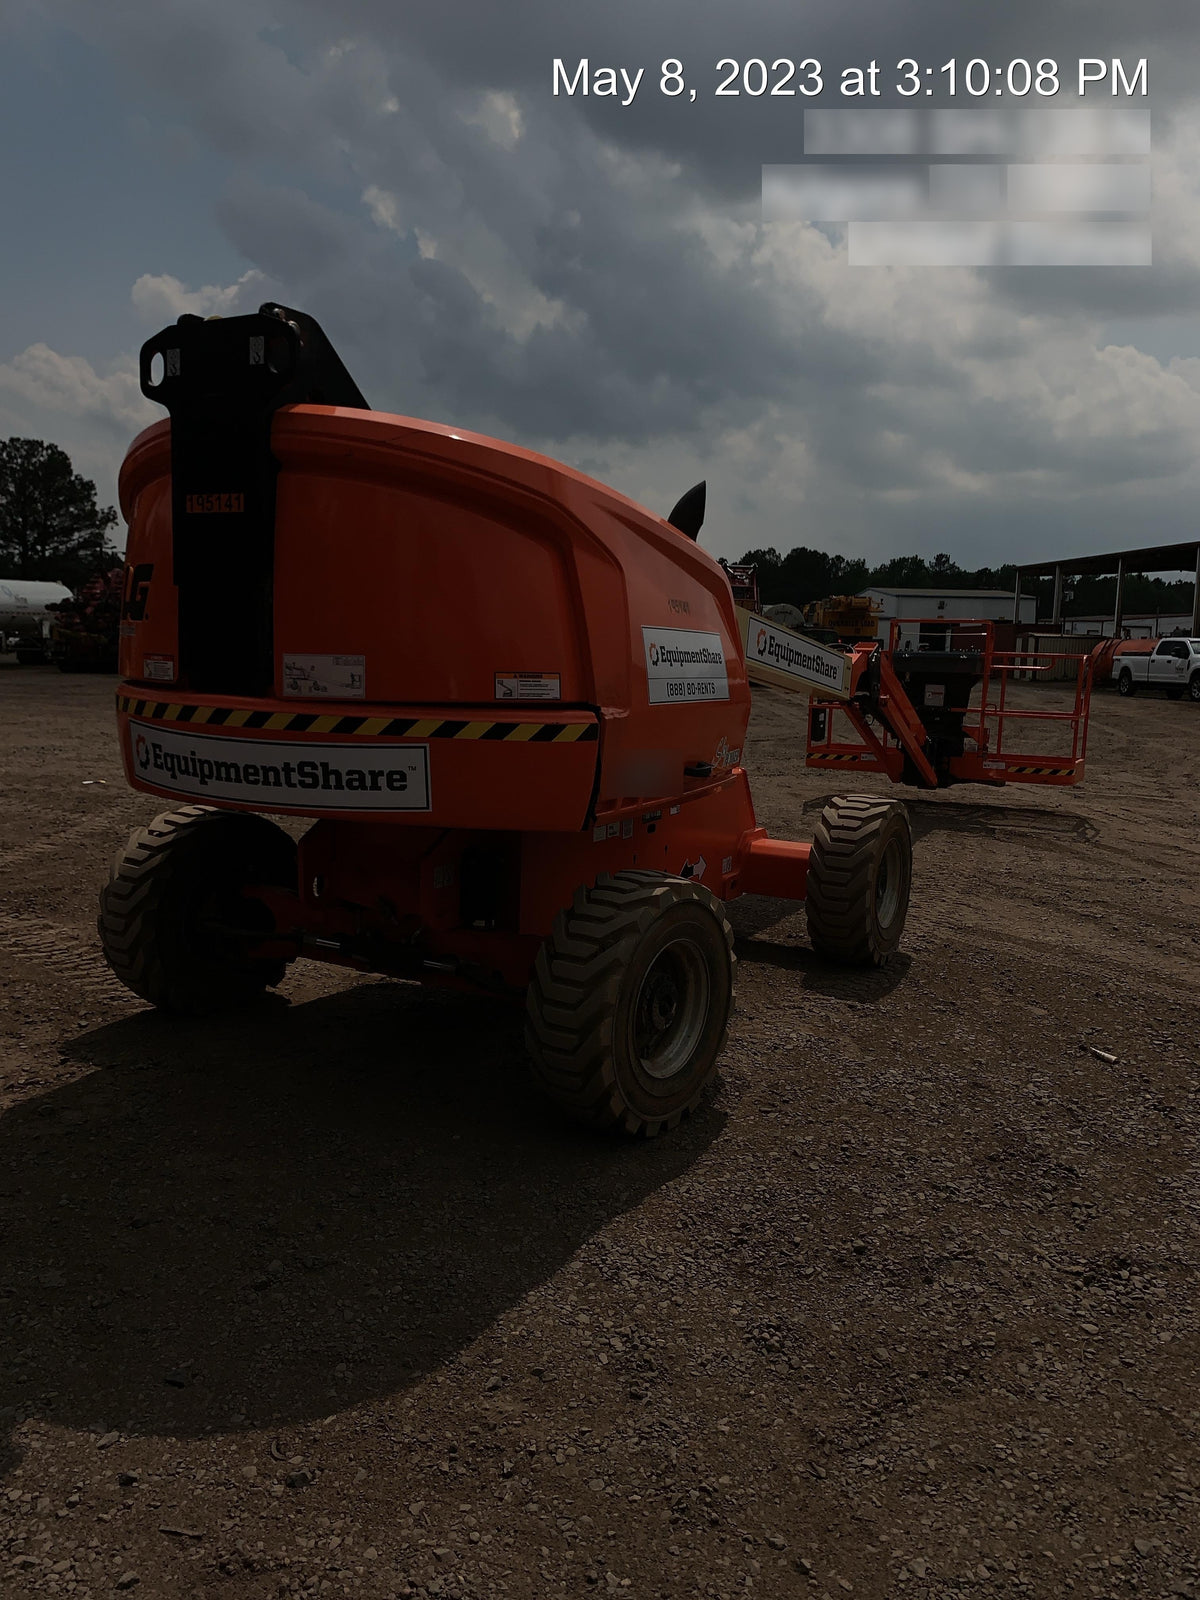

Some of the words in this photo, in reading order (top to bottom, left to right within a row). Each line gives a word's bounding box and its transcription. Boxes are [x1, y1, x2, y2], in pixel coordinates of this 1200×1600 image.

[185, 494, 243, 512] 195141
[659, 645, 722, 667] EquipmentShare
[767, 634, 838, 680] EquipmentShare
[666, 682, 686, 697] (888)
